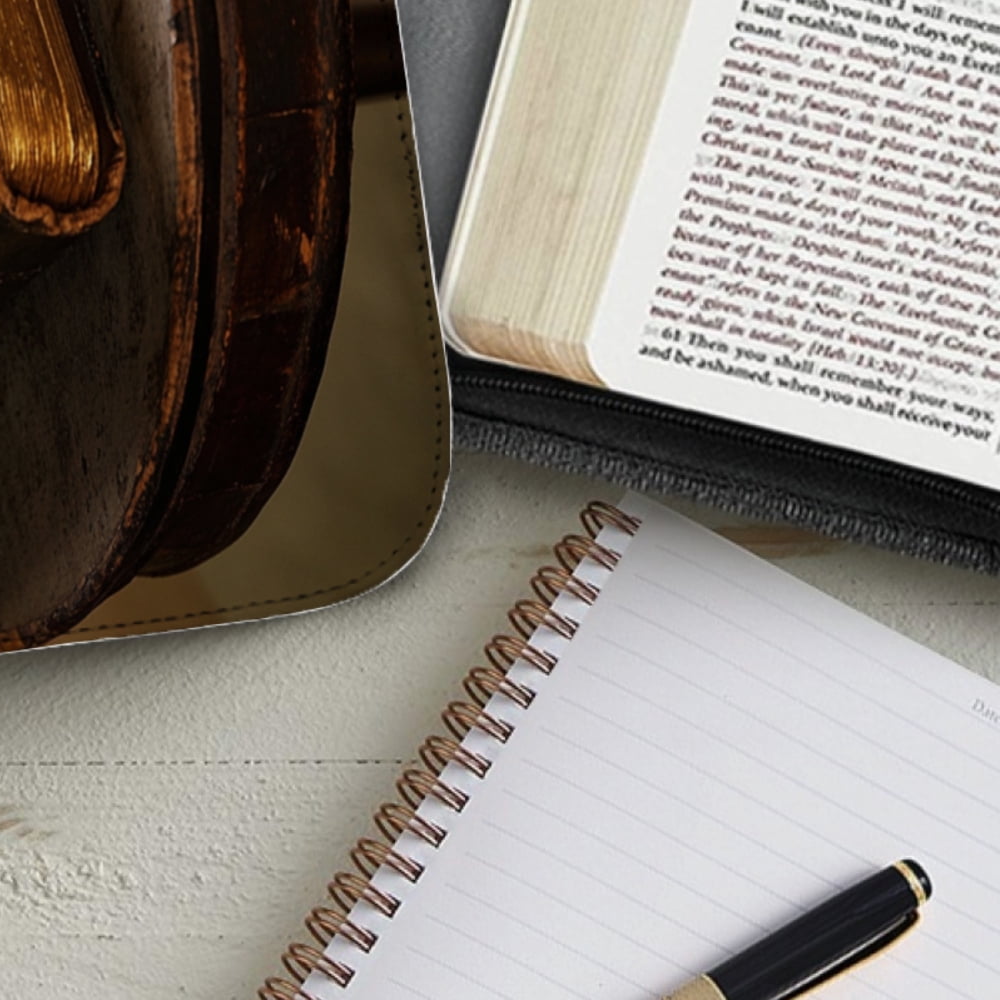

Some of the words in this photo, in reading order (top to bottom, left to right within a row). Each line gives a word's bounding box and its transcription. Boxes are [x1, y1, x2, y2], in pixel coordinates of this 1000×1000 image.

[638, 344, 672, 361] and
[776, 376, 820, 397] when
[821, 388, 854, 405] you
[733, 346, 767, 363] you
[819, 367, 904, 398] remember
